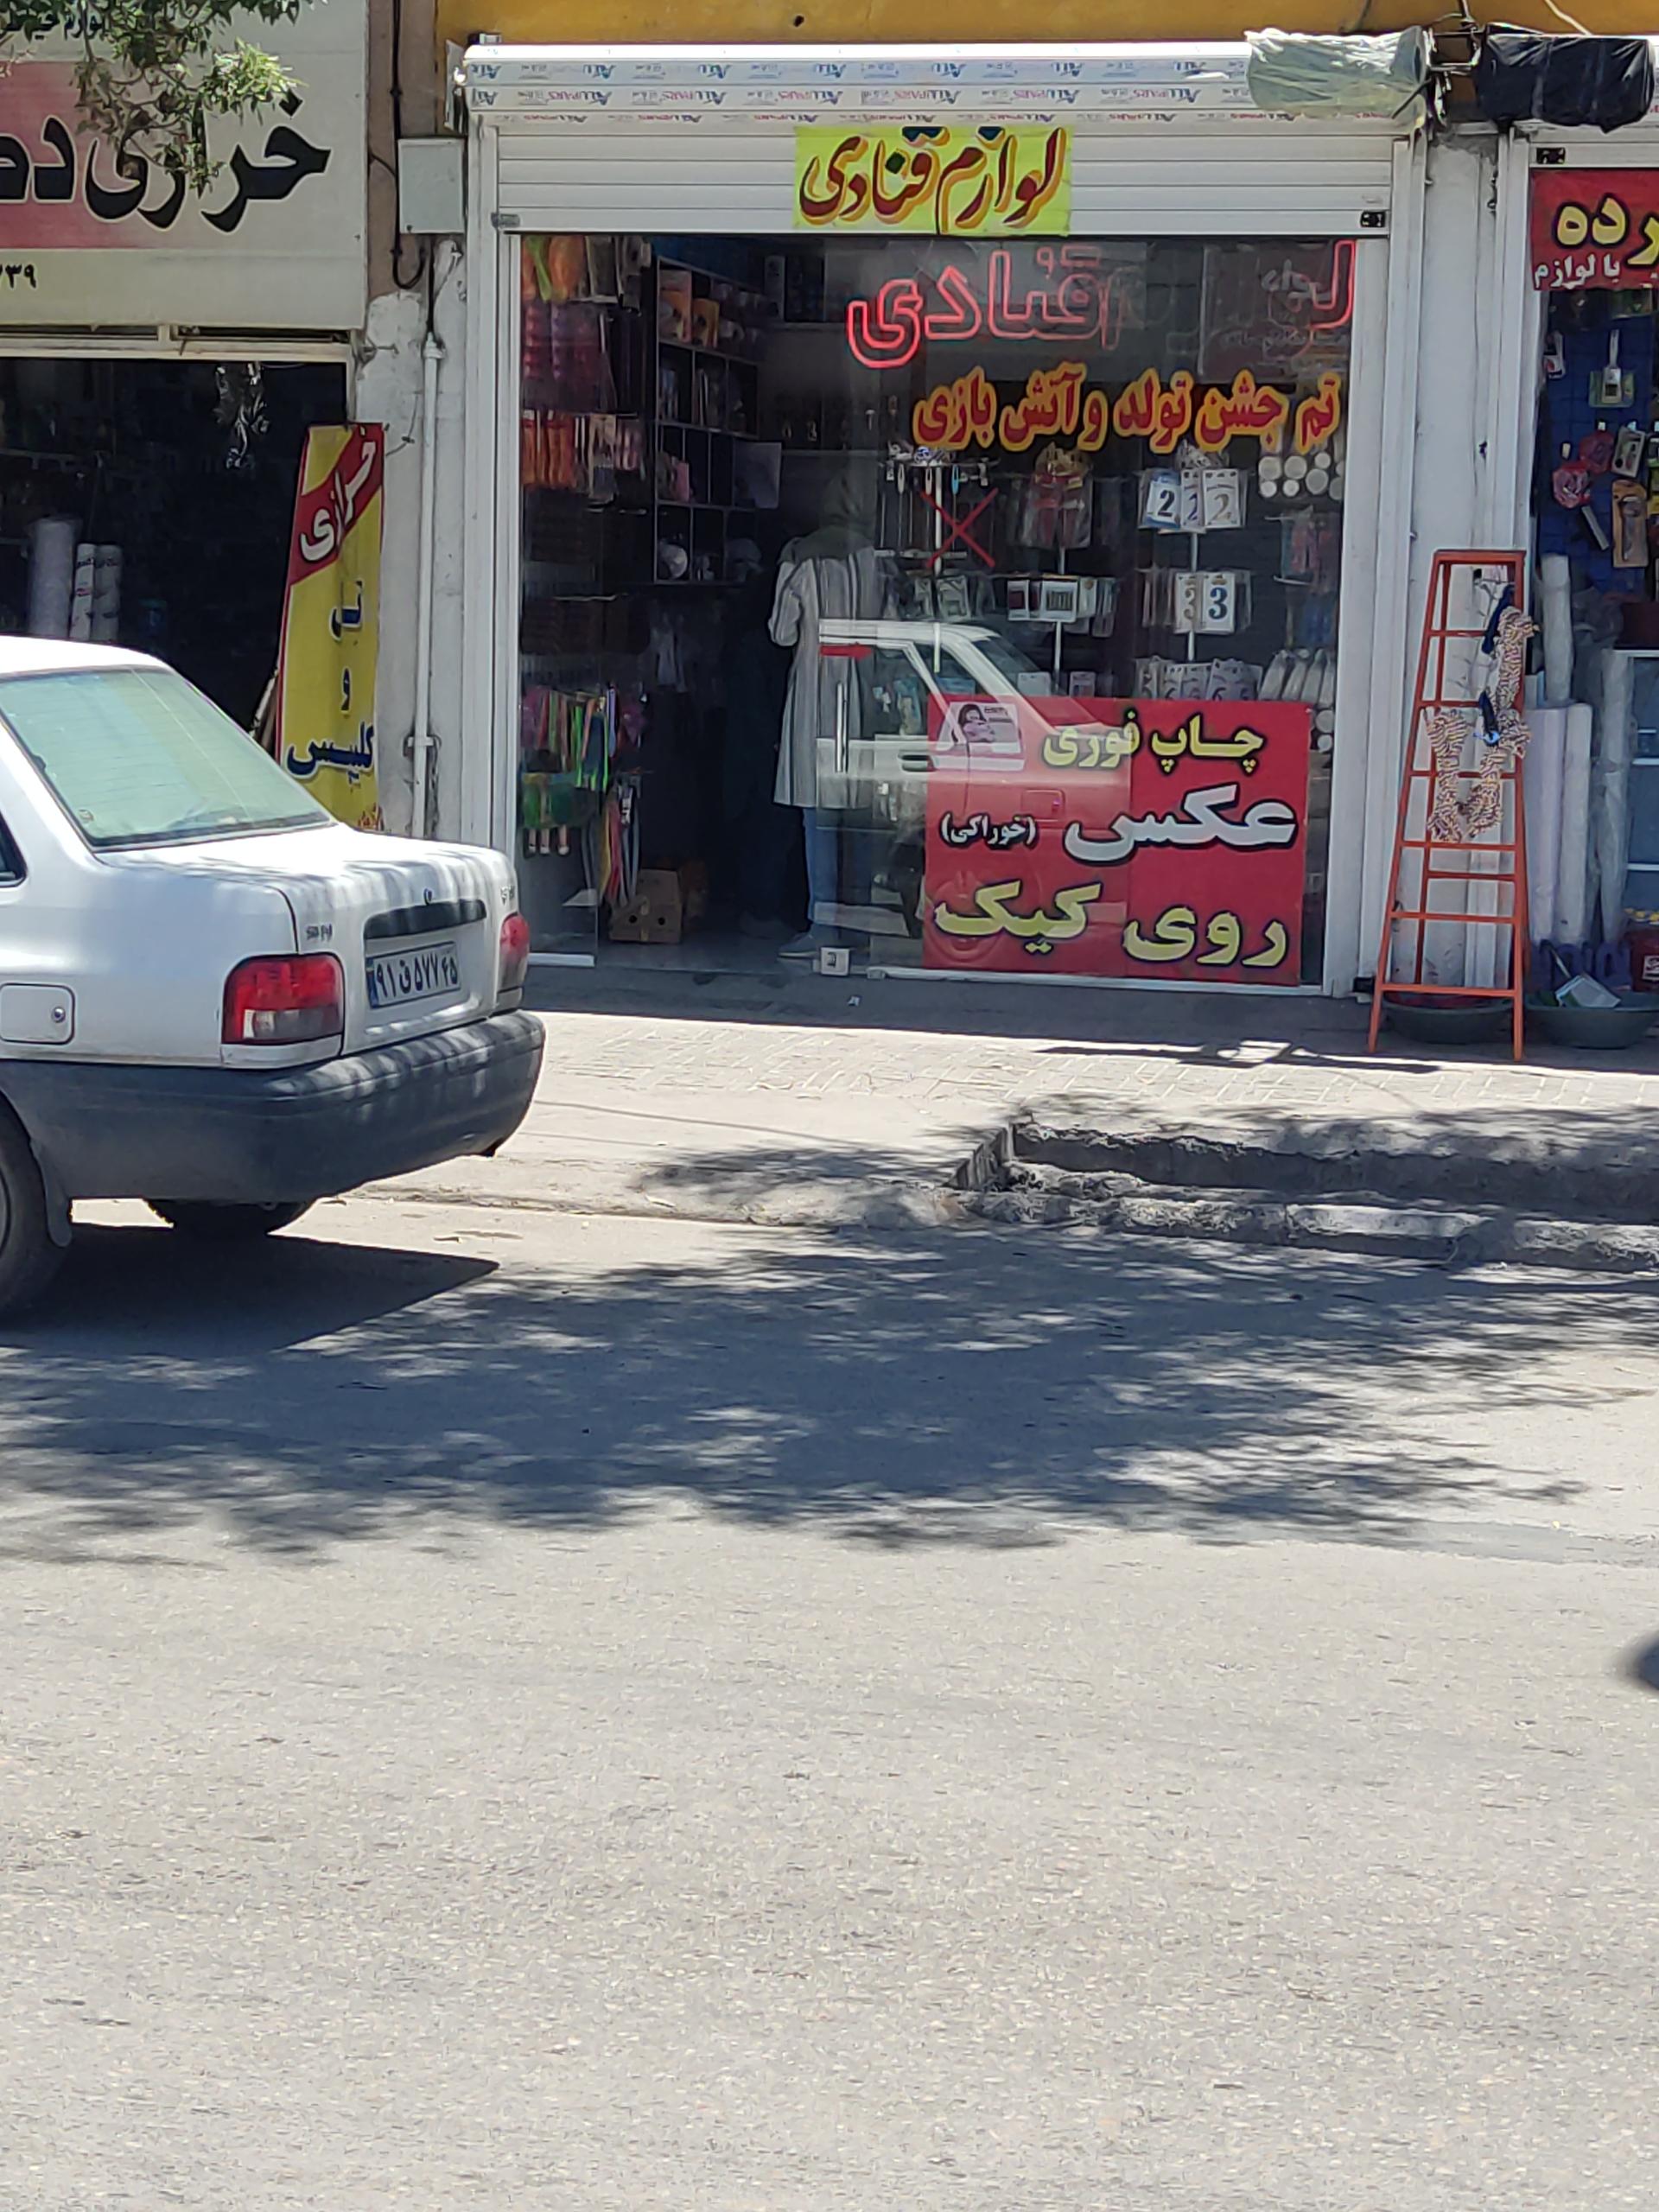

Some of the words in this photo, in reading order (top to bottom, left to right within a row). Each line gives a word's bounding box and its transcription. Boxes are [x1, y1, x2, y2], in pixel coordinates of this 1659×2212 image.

[799, 126, 950, 225] قنادی
[935, 126, 1067, 235] لوازم
[0, 264, 37, 289] ۳۹
[845, 244, 1103, 369] قنادی
[1534, 252, 1597, 290] لوازم
[912, 365, 997, 450] بازی
[999, 360, 1088, 451] آتش
[1080, 389, 1108, 451] و
[1113, 368, 1194, 454] تولد
[1196, 368, 1288, 453] جشن
[1297, 372, 1341, 454] تم
[299, 424, 378, 563] خرازی
[1157, 489, 1176, 518] 2
[1211, 493, 1232, 521] 2
[1208, 587, 1229, 620] 3
[286, 721, 375, 785] کلیپس
[1041, 709, 1143, 769] فوری
[1150, 714, 1268, 773] چاپ
[938, 810, 1039, 849] (خوراکی)
[1062, 782, 1300, 866] عکس
[933, 878, 1103, 955] کیک
[1122, 903, 1291, 969] روی
